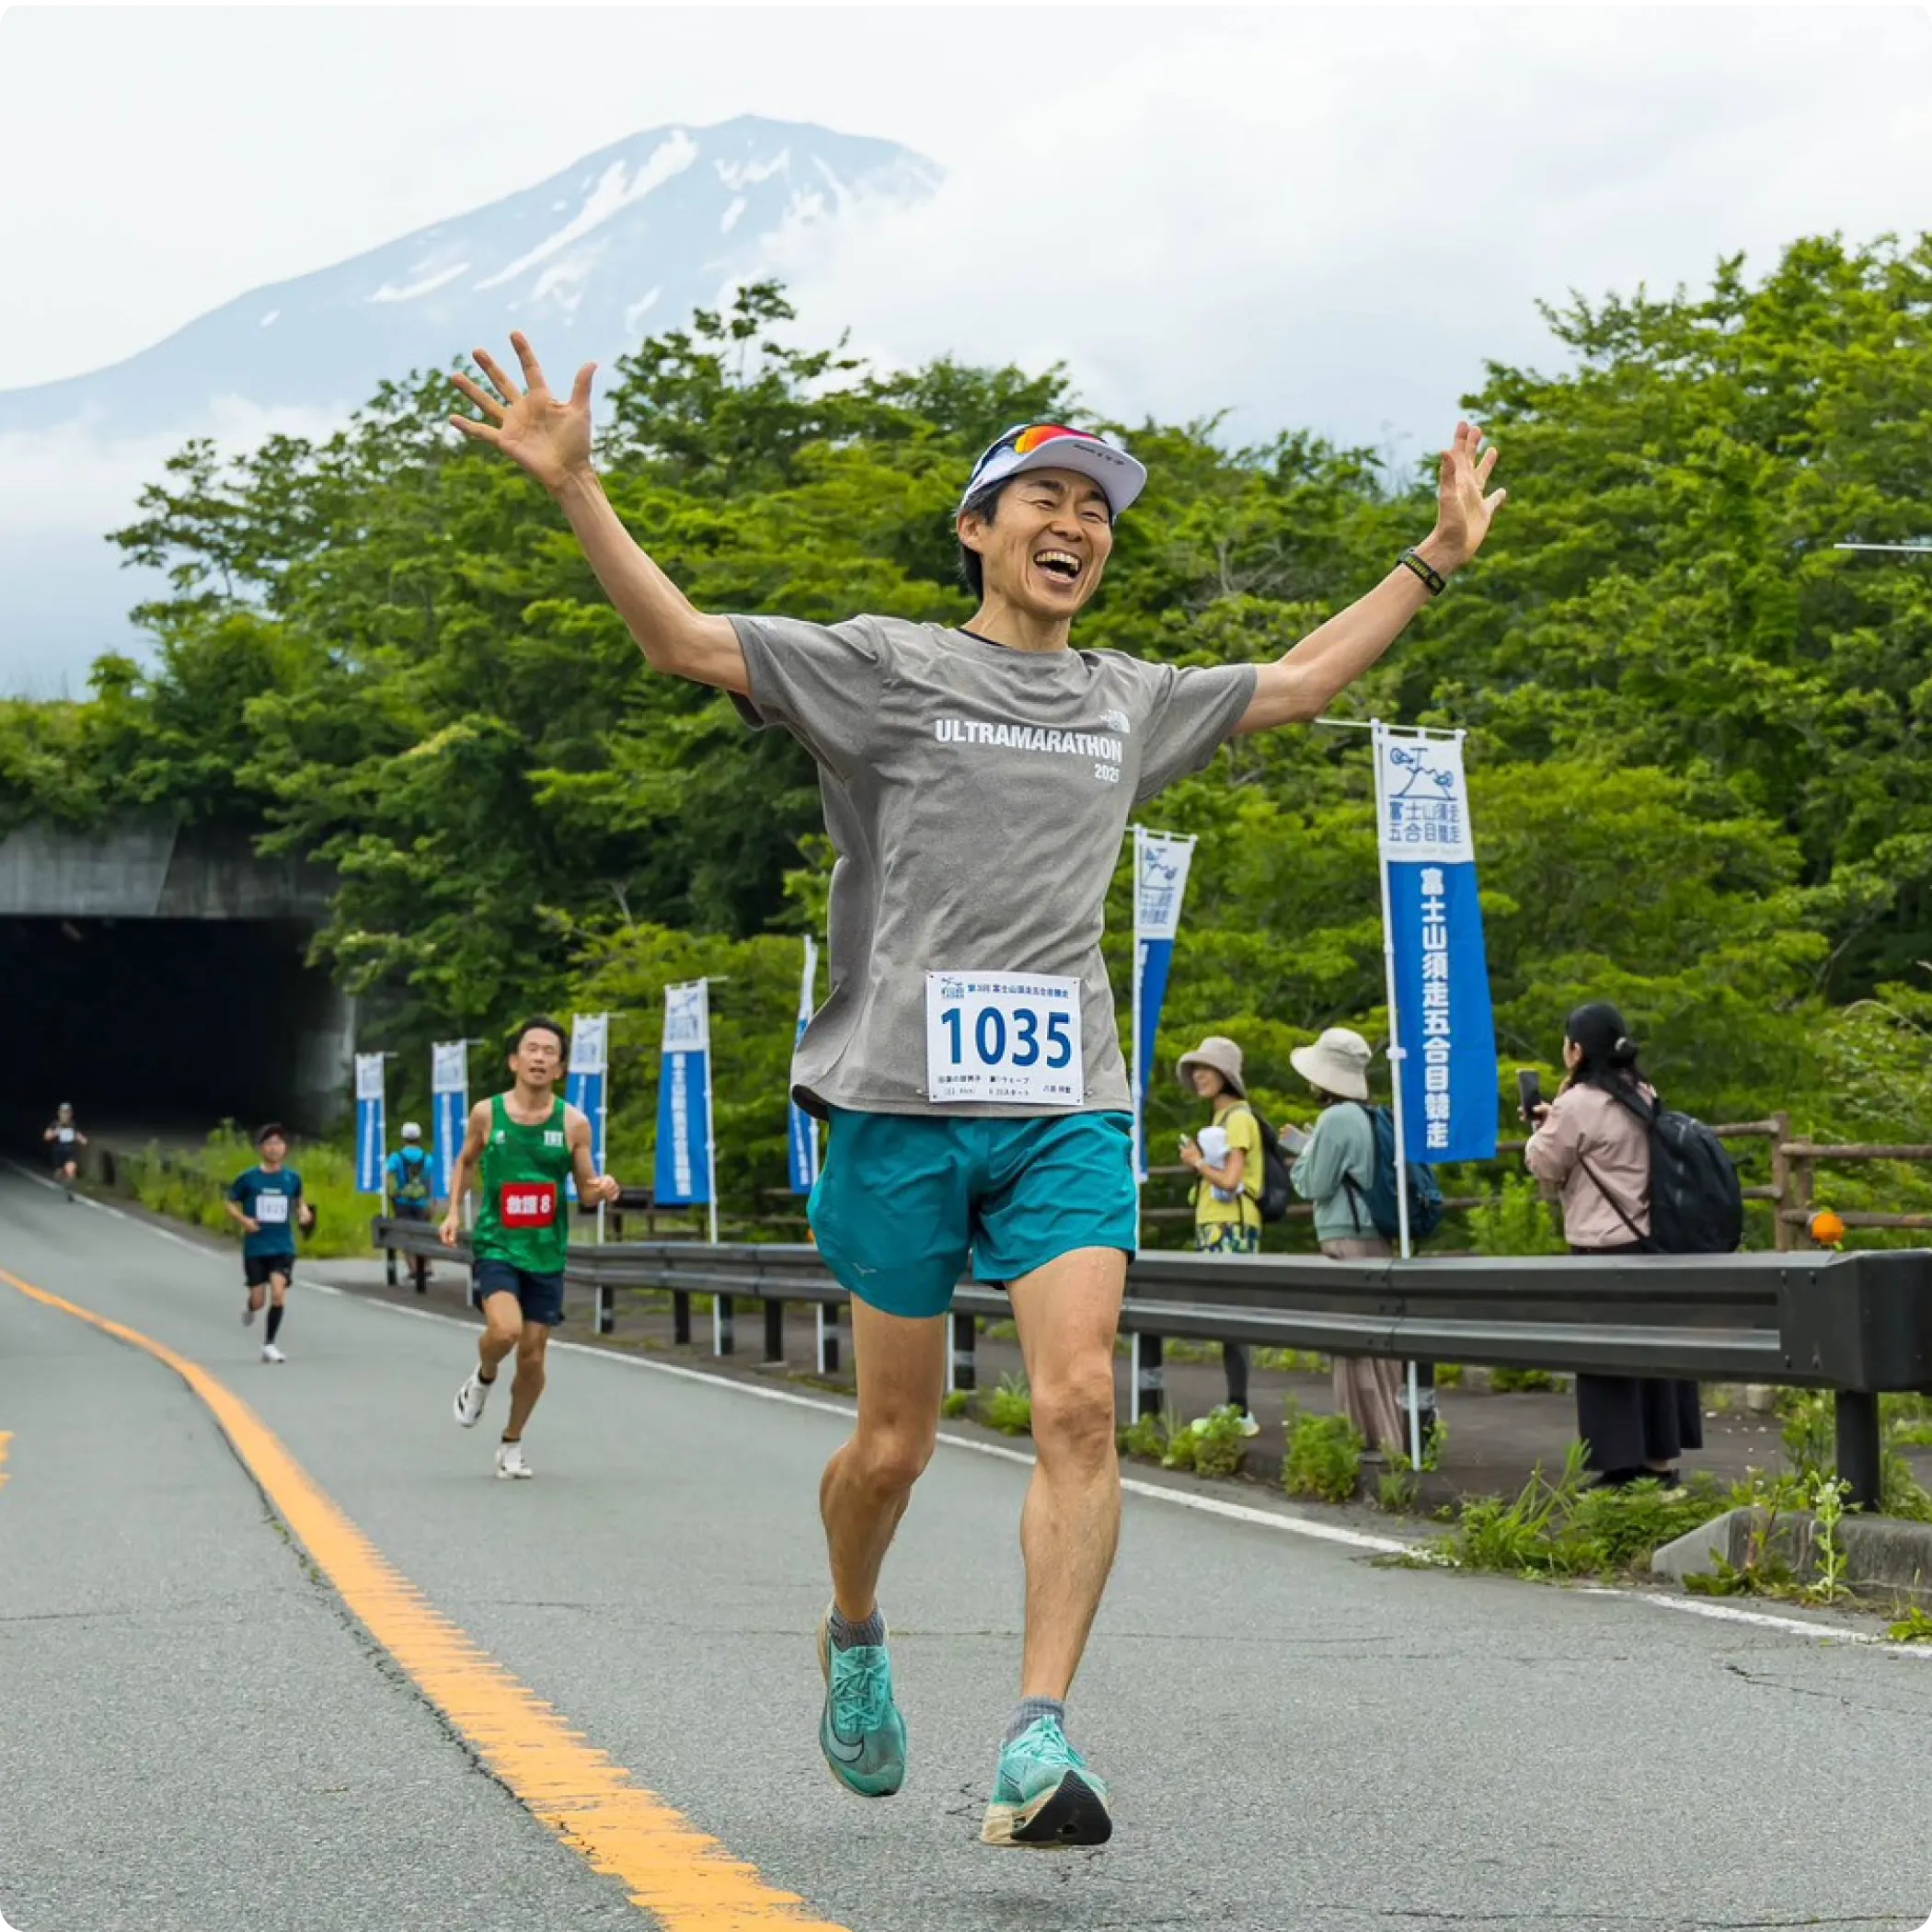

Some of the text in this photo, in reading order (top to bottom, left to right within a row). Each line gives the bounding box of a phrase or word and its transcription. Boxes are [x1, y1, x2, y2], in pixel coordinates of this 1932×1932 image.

[935, 719, 1122, 763] ULTRAMARATHON
[941, 1006, 1072, 1068] 1035
[1420, 868, 1451, 1148] 富士山須走五合目競走
